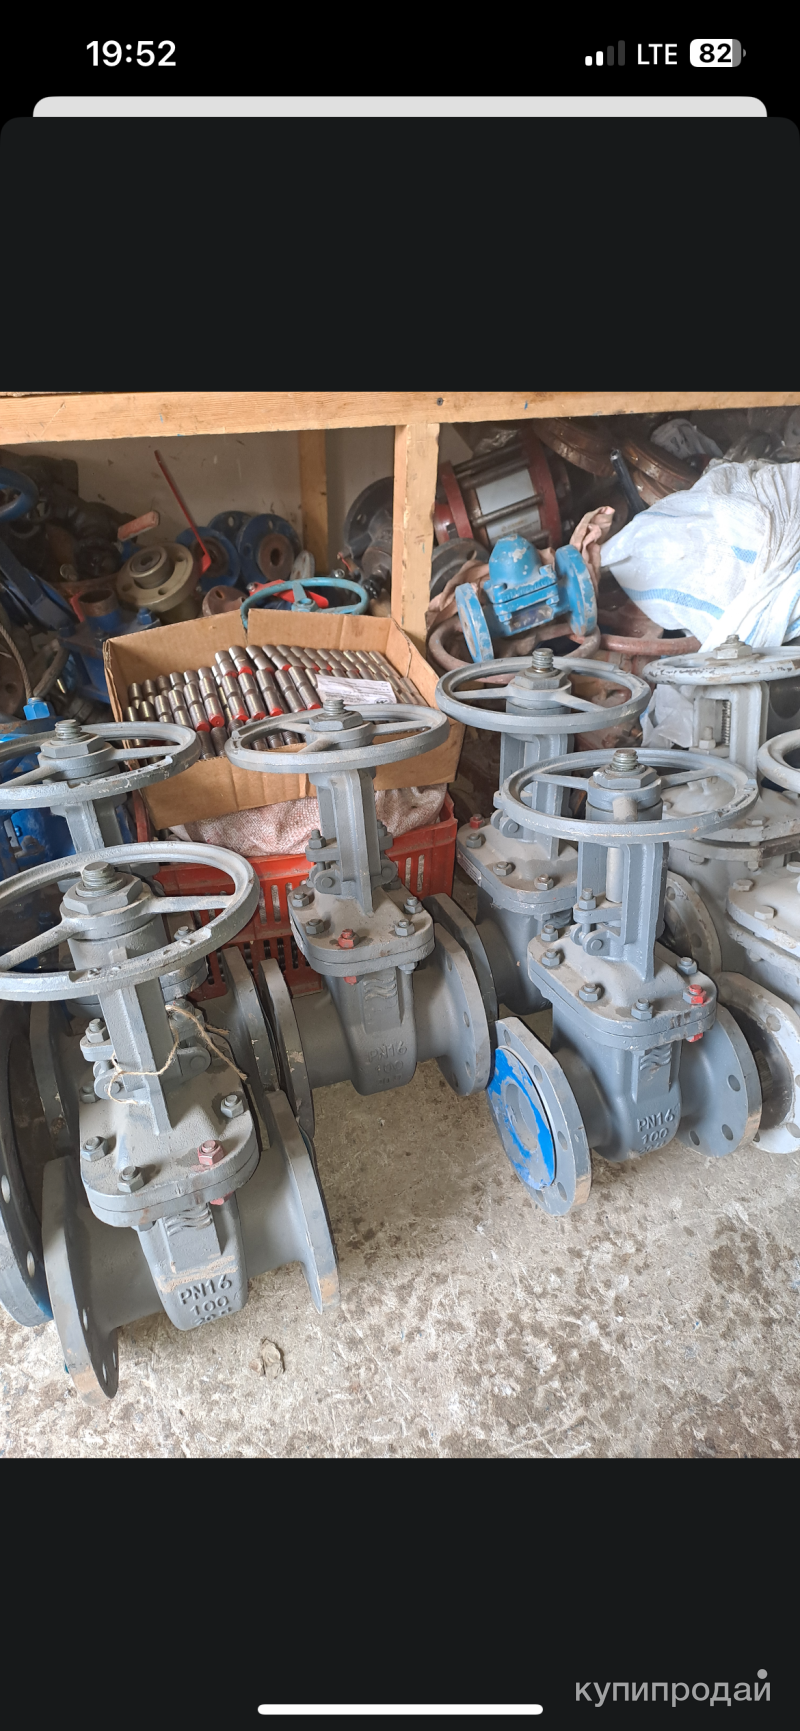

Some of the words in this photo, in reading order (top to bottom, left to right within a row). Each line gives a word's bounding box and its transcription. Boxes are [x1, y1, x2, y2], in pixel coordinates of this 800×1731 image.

[86, 39, 177, 67] 19:52
[637, 43, 678, 65] LTE
[699, 43, 732, 63] 82
[367, 1040, 408, 1062] PN16
[636, 1108, 676, 1133] PN16
[641, 1127, 669, 1145] 100
[178, 1274, 233, 1306] PN16
[190, 1295, 230, 1316] 100
